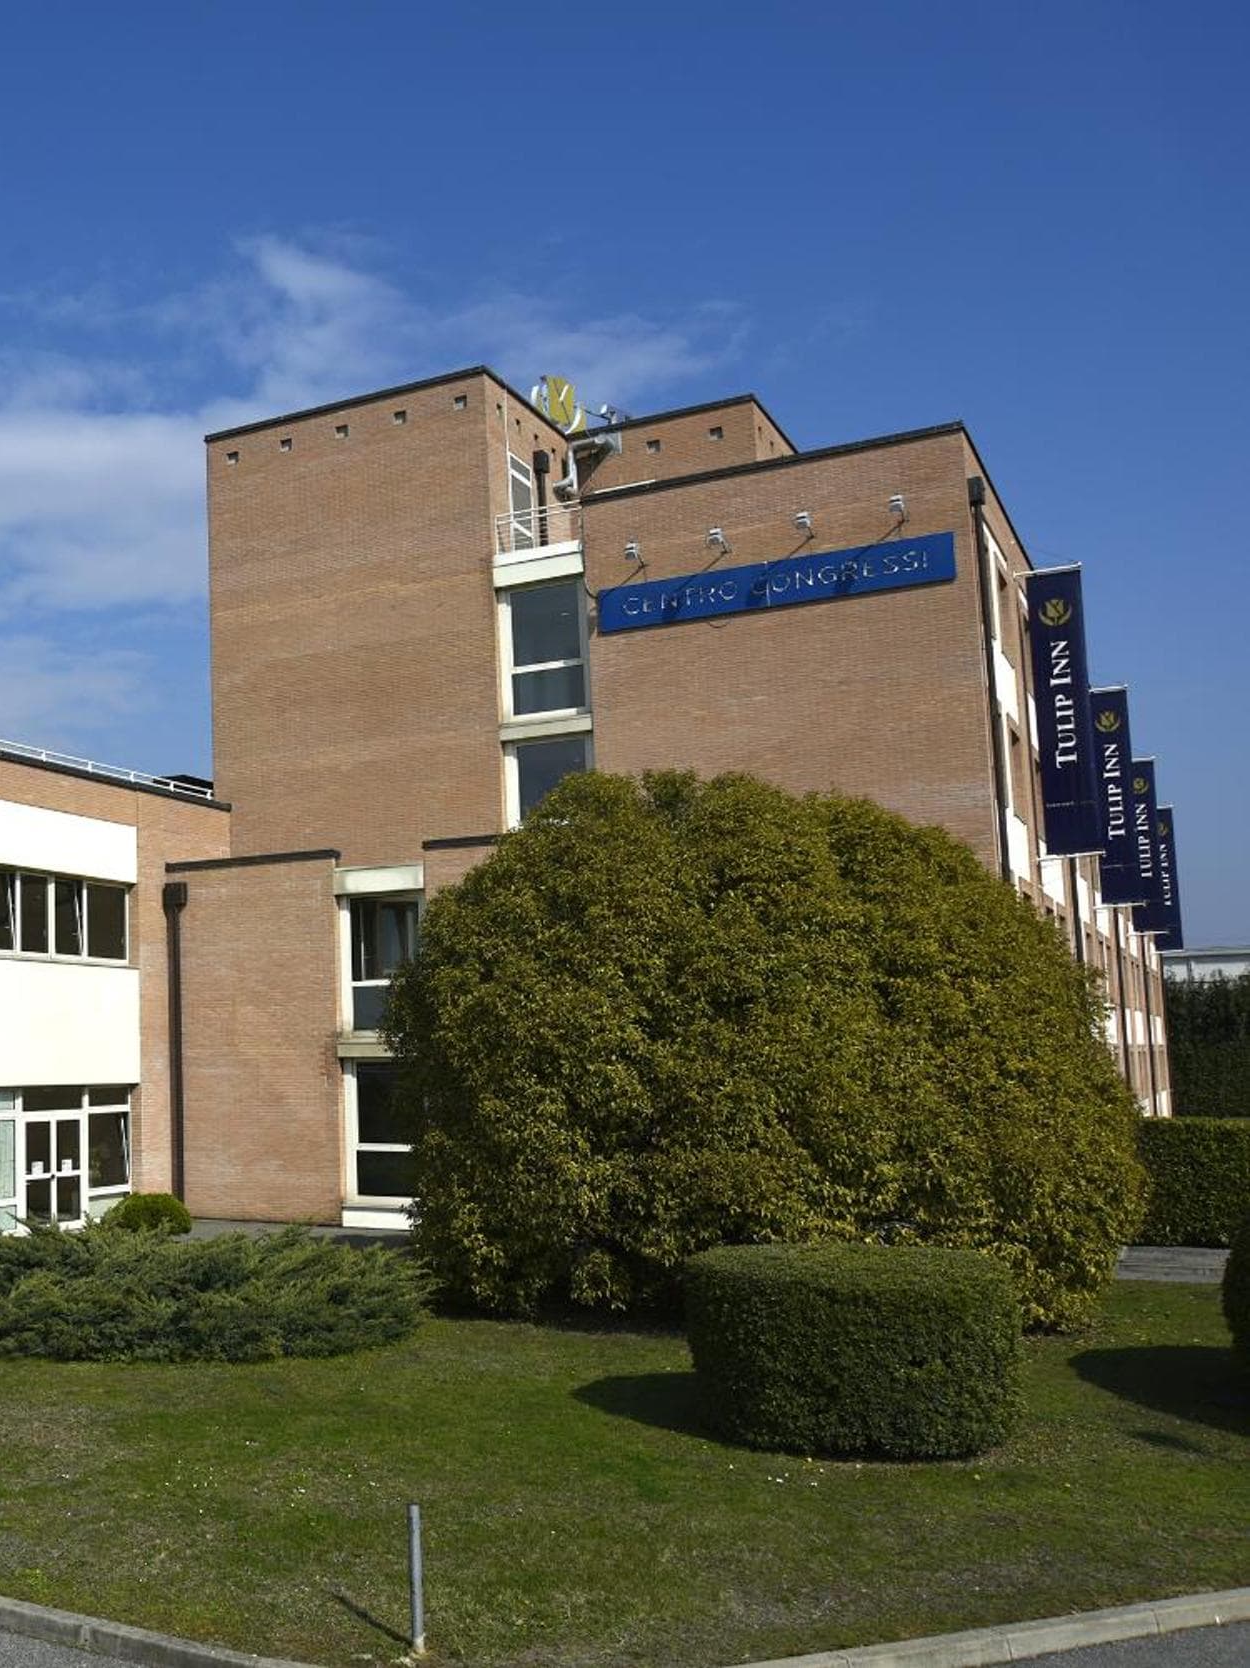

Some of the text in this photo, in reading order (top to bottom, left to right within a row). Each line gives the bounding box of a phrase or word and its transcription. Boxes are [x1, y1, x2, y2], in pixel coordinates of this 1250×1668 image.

[622, 550, 929, 615] CENTRO CONGRESSI
[1050, 640, 1078, 769] TULIP INN
[1103, 743, 1126, 840] TULIP INN
[1134, 803, 1150, 831] INN
